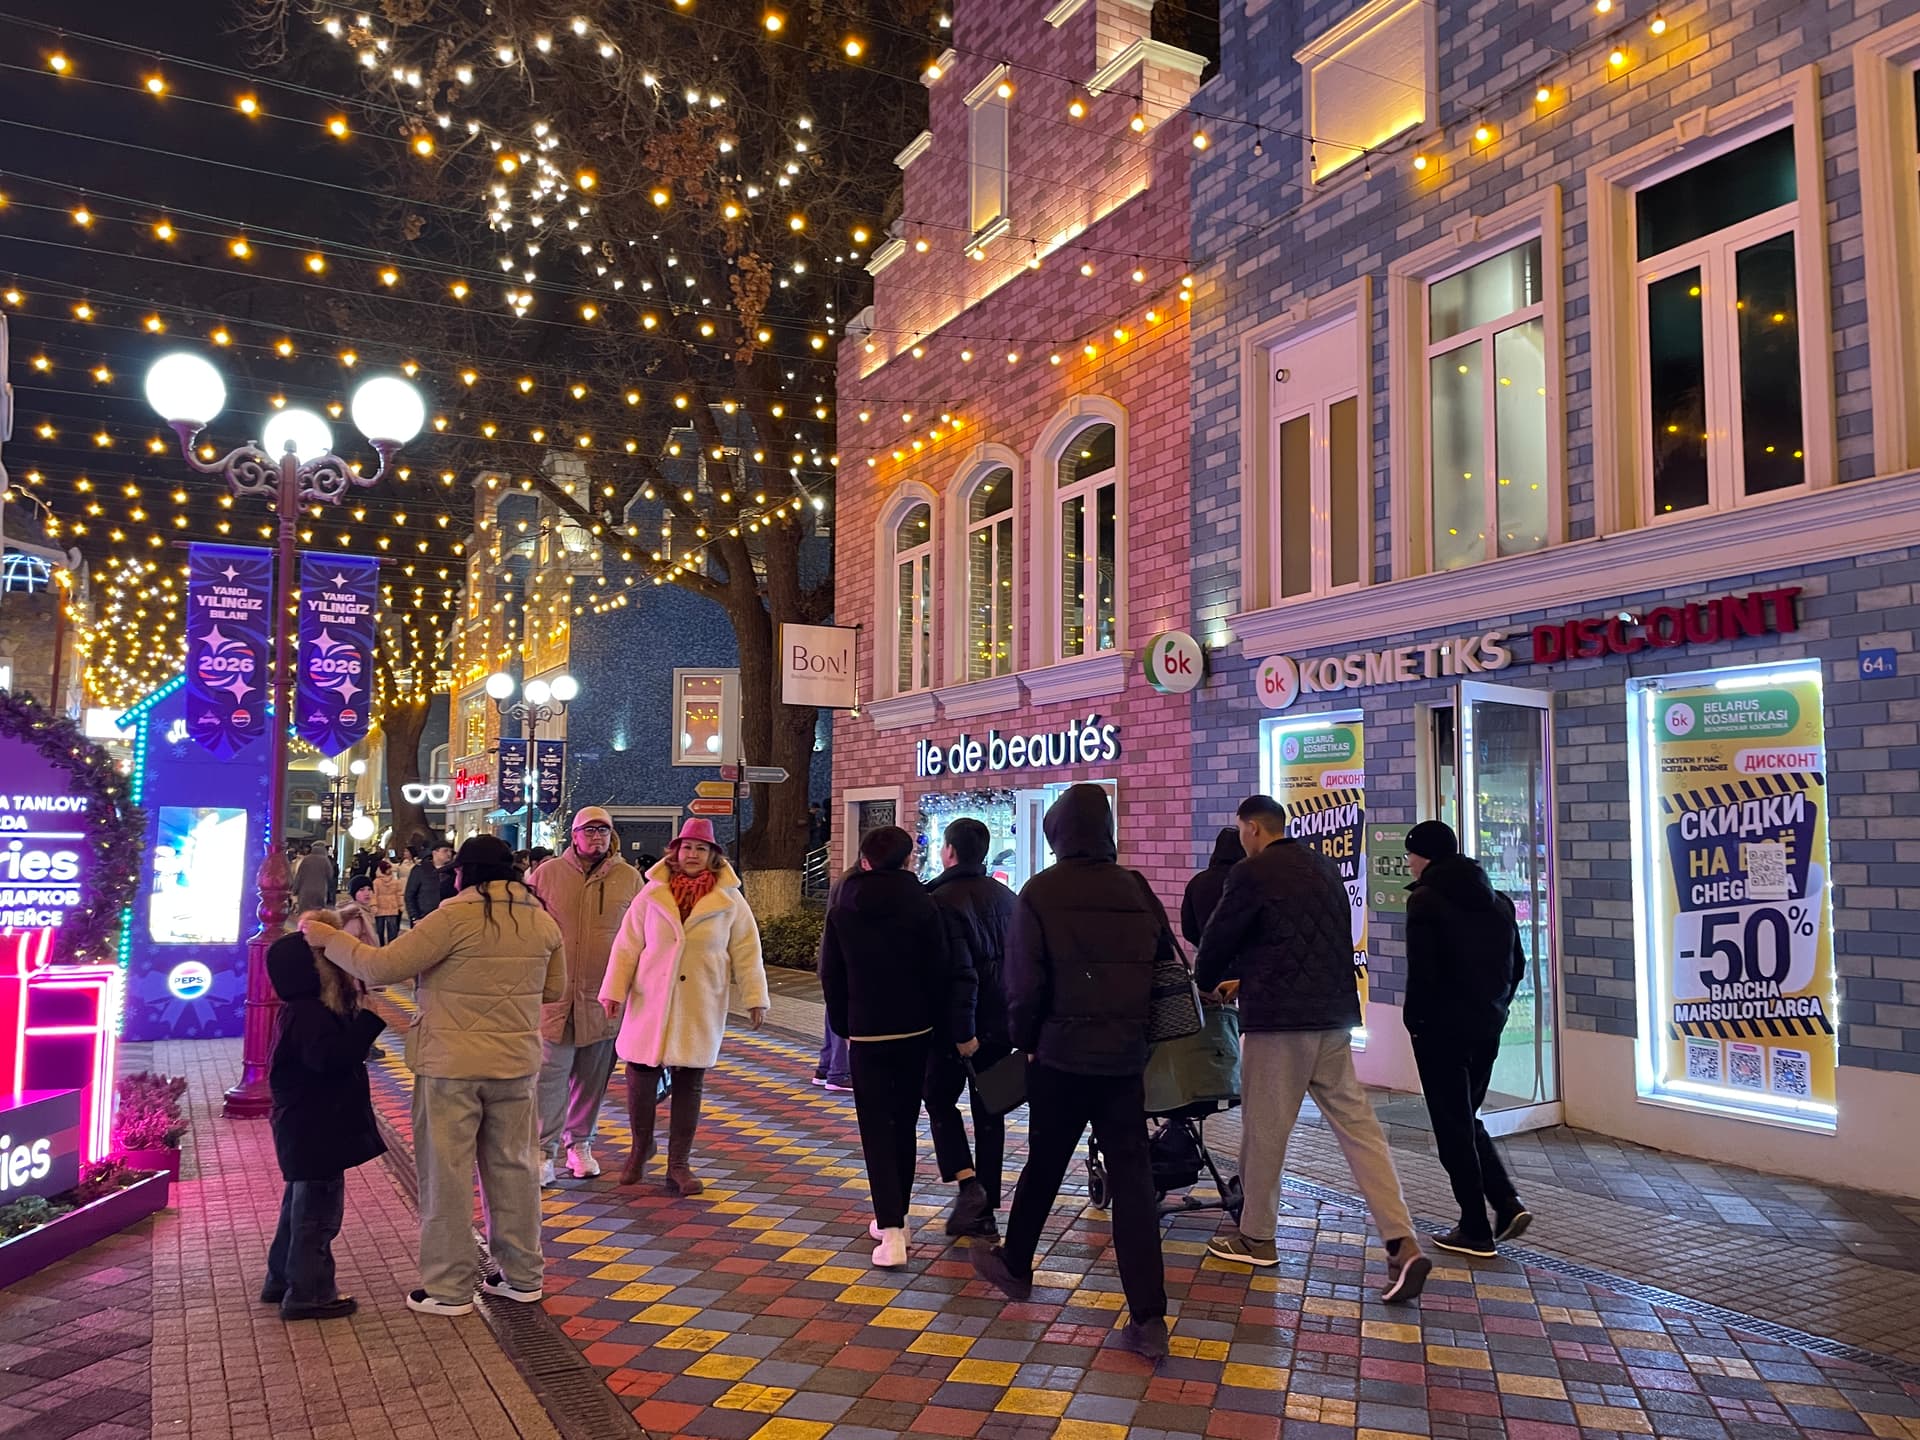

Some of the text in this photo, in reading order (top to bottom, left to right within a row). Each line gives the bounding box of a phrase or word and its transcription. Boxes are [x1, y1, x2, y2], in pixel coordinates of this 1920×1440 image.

[212, 586, 248, 597] YANGI
[322, 592, 356, 602] YANGI
[197, 595, 262, 610] YILINGIZ
[307, 600, 370, 615] YILINGIZ
[1532, 587, 1802, 664] DISCOUNT
[199, 656, 254, 672] 2026
[309, 658, 361, 674] 2026
[1165, 649, 1192, 674] bk
[1265, 671, 1286, 693] bk
[1703, 700, 1760, 713] BELARUS
[1703, 710, 1788, 725] KOSMETIKASI
[949, 734, 982, 774] de
[989, 714, 1116, 770] beautés
[1303, 734, 1335, 745] BELARUS
[1744, 753, 1818, 772] ДИСКОНТ
[1325, 774, 1365, 788] ДИСКОНТ
[13, 796, 88, 812] TANLOV:
[0, 815, 28, 830] DA
[1290, 803, 1359, 839] СКИДКИ
[1681, 793, 1805, 841] СКИДКИ
[1322, 830, 1354, 859] ВСЁ
[1689, 829, 1796, 878] НА ВЁ
[1691, 873, 1798, 905] CHEGIA
[0, 890, 80, 907] ДАРКОВ
[1680, 906, 1813, 984] -50%
[1710, 981, 1780, 1001] BARCHA
[1675, 999, 1823, 1023] MAHSULOTLARGA
